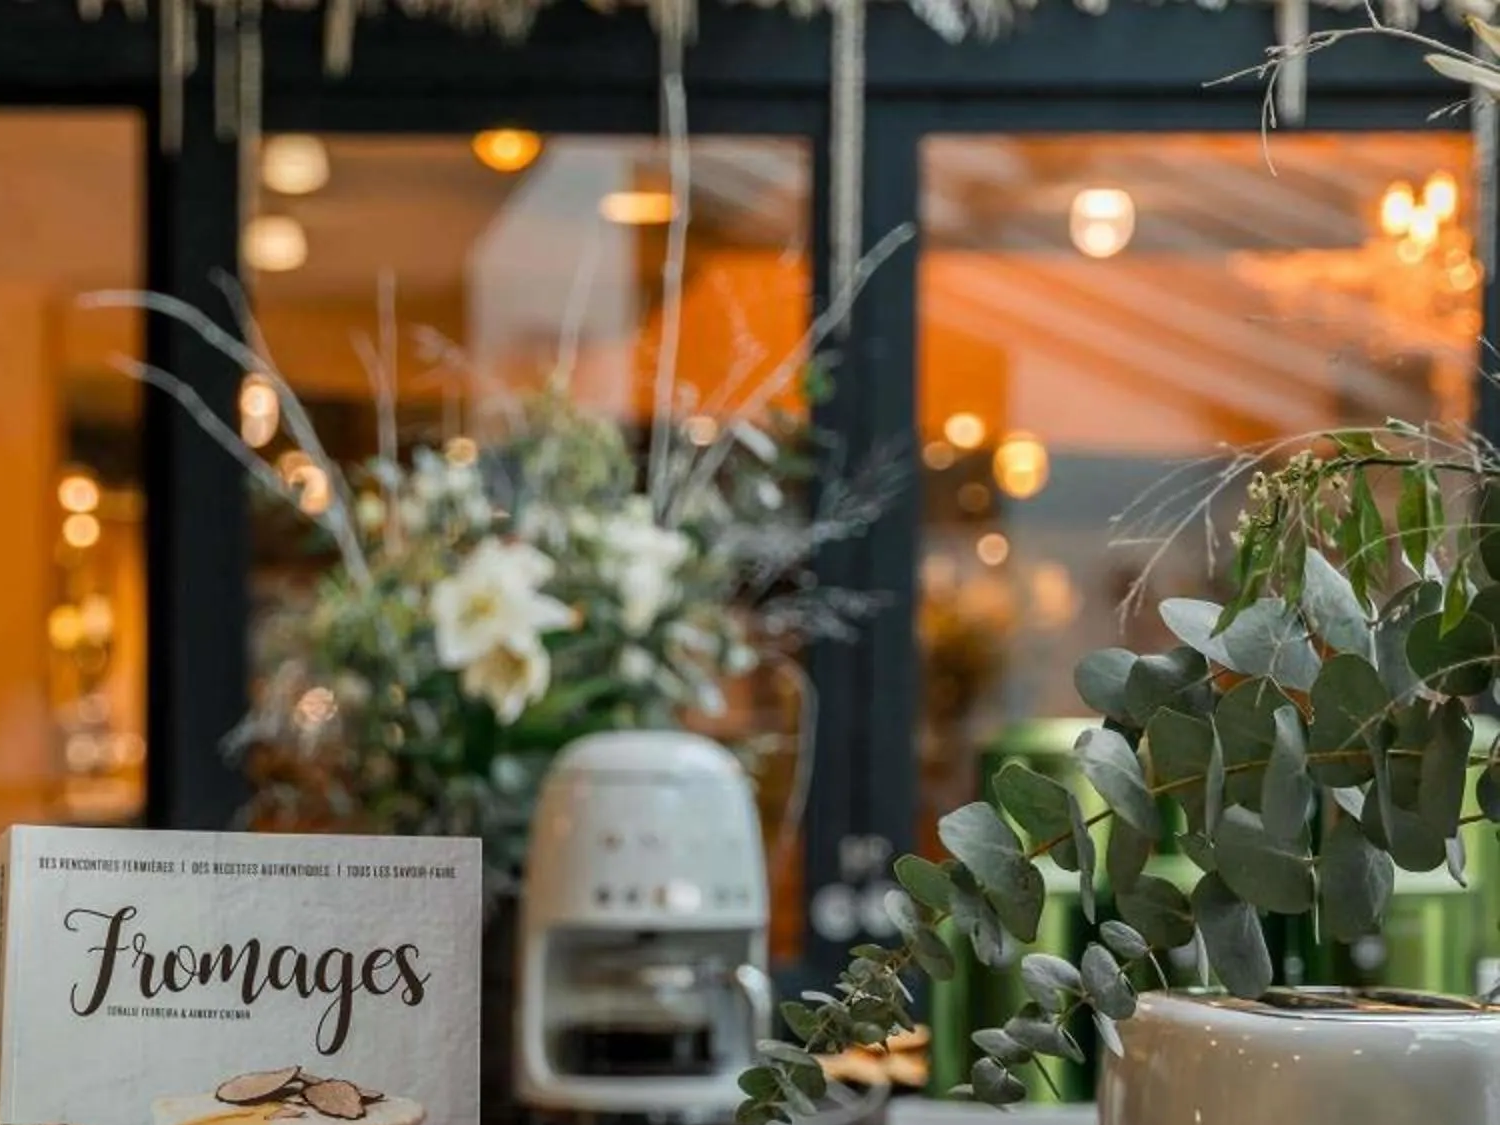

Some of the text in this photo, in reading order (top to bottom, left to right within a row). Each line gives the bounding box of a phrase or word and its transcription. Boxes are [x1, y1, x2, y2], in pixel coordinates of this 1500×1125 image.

[191, 862, 210, 875] DES
[346, 865, 370, 878] TOUS
[373, 865, 390, 878] LES
[64, 906, 431, 1055] Fromages
